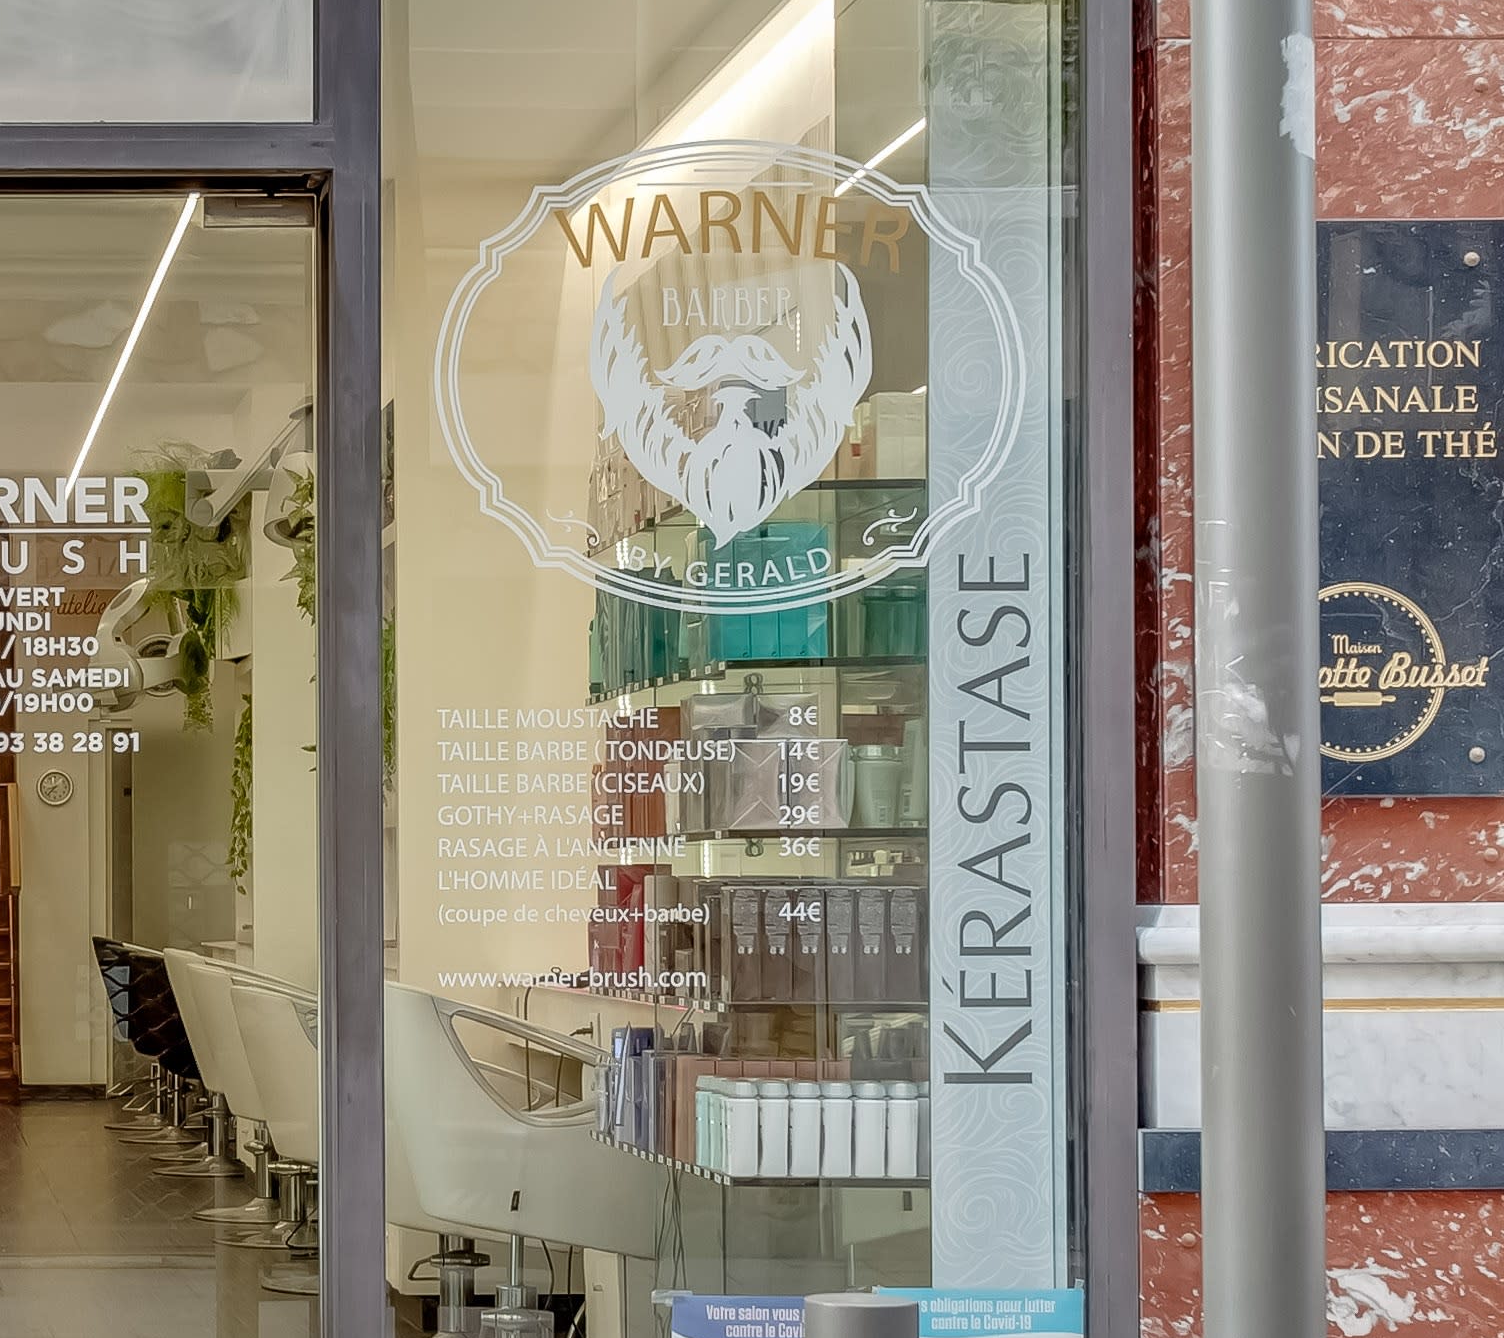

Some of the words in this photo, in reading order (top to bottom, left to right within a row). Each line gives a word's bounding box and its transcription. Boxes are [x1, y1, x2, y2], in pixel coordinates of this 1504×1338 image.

[554, 190, 911, 274] WARNER
[662, 286, 795, 332] BARBER
[1316, 340, 1481, 369] ICATION
[1316, 386, 1479, 414] SANALE
[1355, 430, 1405, 459] DE
[1417, 423, 1498, 459] THÉ
[629, 544, 672, 581] BY
[686, 546, 832, 589] GERALD
[23, 636, 99, 656] 18H30
[1331, 634, 1383, 656] Maison
[31, 668, 129, 689] SAMEDI
[1379, 651, 1489, 689] Busset
[438, 709, 509, 729] TAILLE
[516, 707, 658, 729] MOUSTACHE
[788, 705, 817, 726] 8€
[33, 732, 64, 753] 38
[72, 731, 103, 753] 28
[112, 731, 140, 753] 91
[438, 741, 509, 761] TAILLE
[516, 741, 587, 761] BARBE
[777, 740, 820, 761] 14€
[438, 773, 509, 793] TAILLE
[516, 773, 587, 793] BARBE
[594, 771, 705, 794] (CISEAUX)
[778, 772, 820, 793] 19€
[438, 804, 624, 826] GOTHY+RASAGE
[778, 804, 820, 825] 29€
[942, 553, 1033, 1085] KÉRASTASE
[438, 837, 528, 858] RASAGE
[534, 833, 550, 858] À
[557, 836, 686, 858] L'ANCIENNE
[778, 836, 820, 858] 36€
[438, 870, 544, 891] L'HOMME
[551, 865, 616, 891] IDÉAL
[438, 902, 508, 925] (coupe
[514, 903, 538, 923] de
[543, 903, 711, 925] cheveux+barbe)
[778, 901, 821, 922] 44€
[438, 967, 706, 989] www.warner-brush.com
[778, 1321, 805, 1338] Covi
